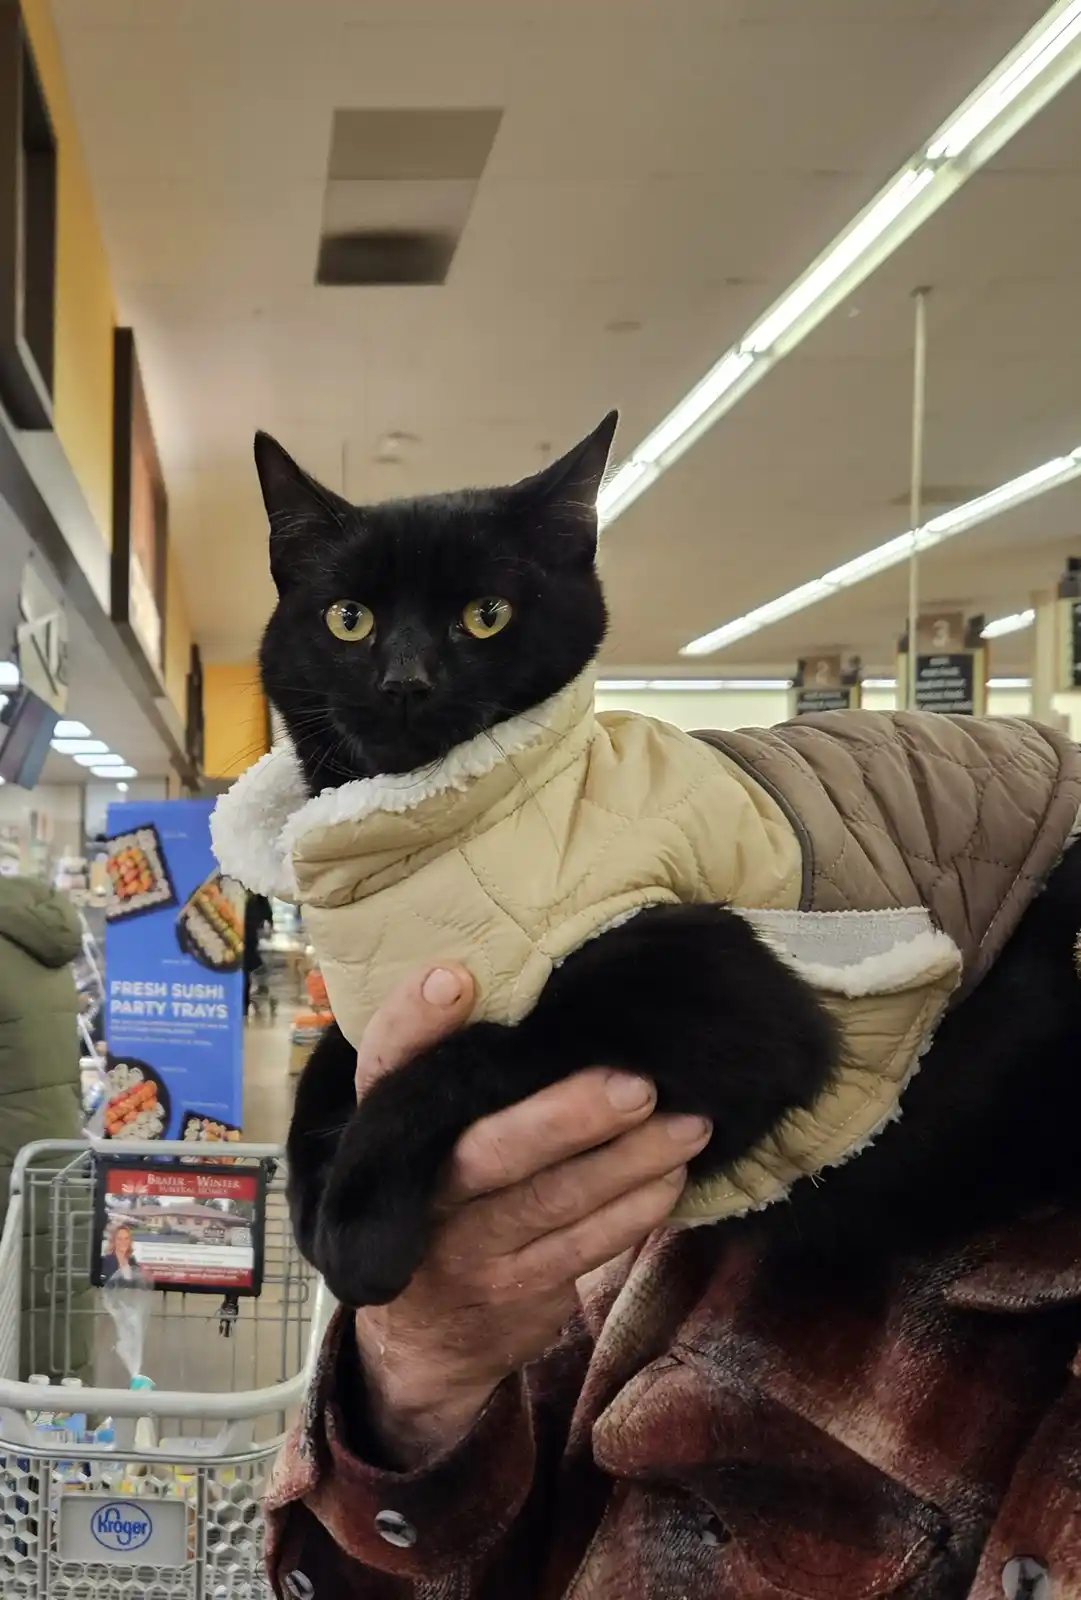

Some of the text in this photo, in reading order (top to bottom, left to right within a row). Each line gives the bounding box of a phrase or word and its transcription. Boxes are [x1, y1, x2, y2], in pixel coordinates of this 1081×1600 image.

[111, 981, 224, 999] FRESH SUSHI
[110, 1000, 228, 1019] PARTY TRAYS
[98, 1508, 148, 1545] Kroger
